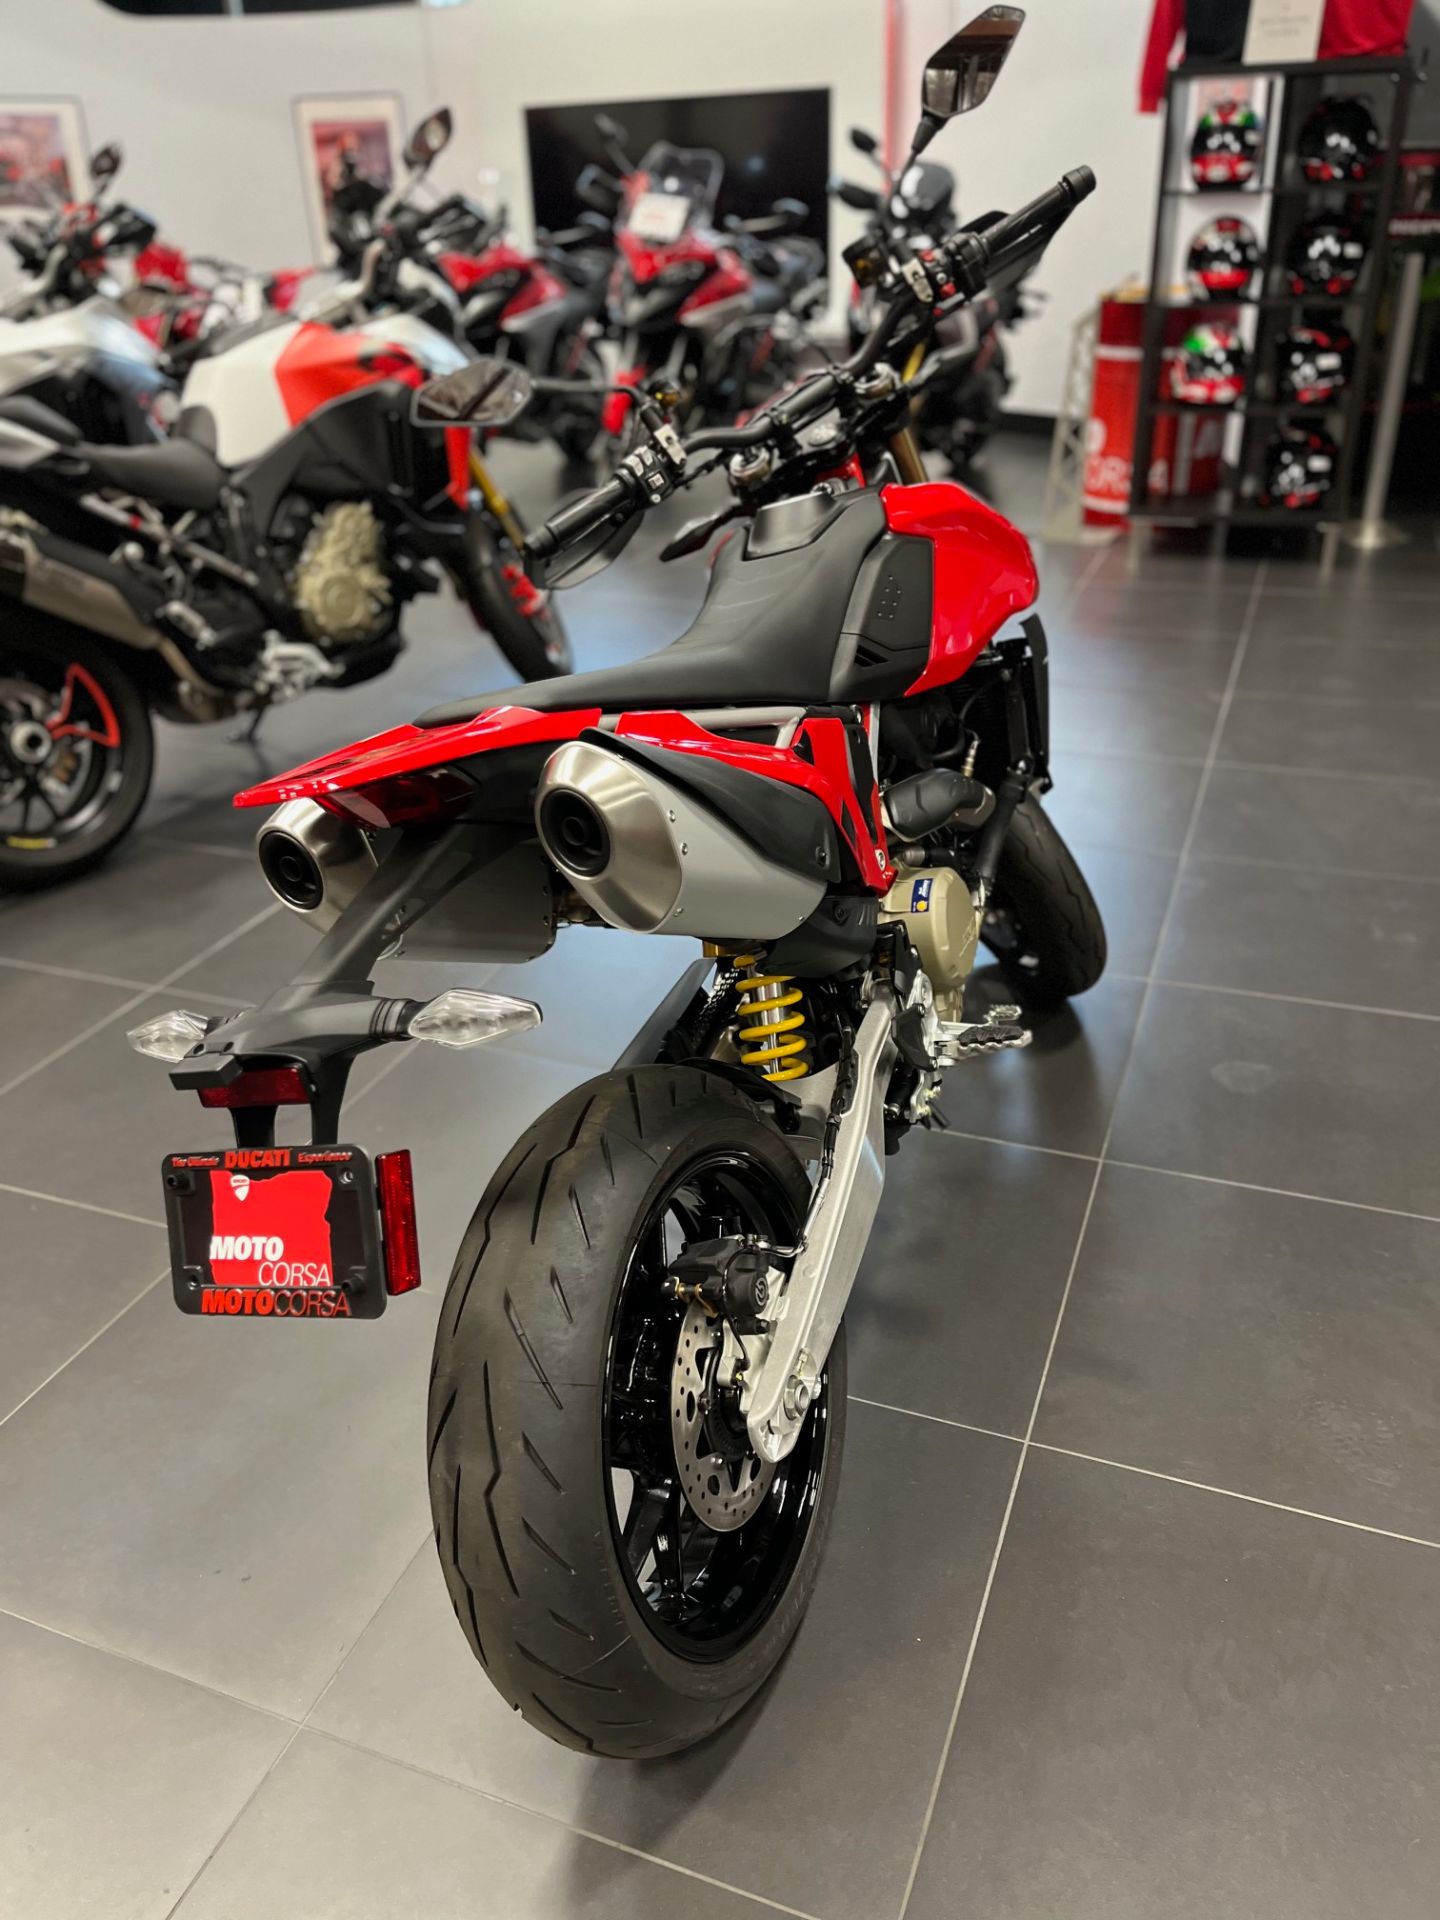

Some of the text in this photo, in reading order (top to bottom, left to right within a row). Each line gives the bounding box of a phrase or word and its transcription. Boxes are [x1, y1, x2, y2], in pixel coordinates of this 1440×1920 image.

[224, 1148, 290, 1168] DUCATI
[209, 1235, 284, 1261] MOTO
[258, 1262, 331, 1287] CORSA
